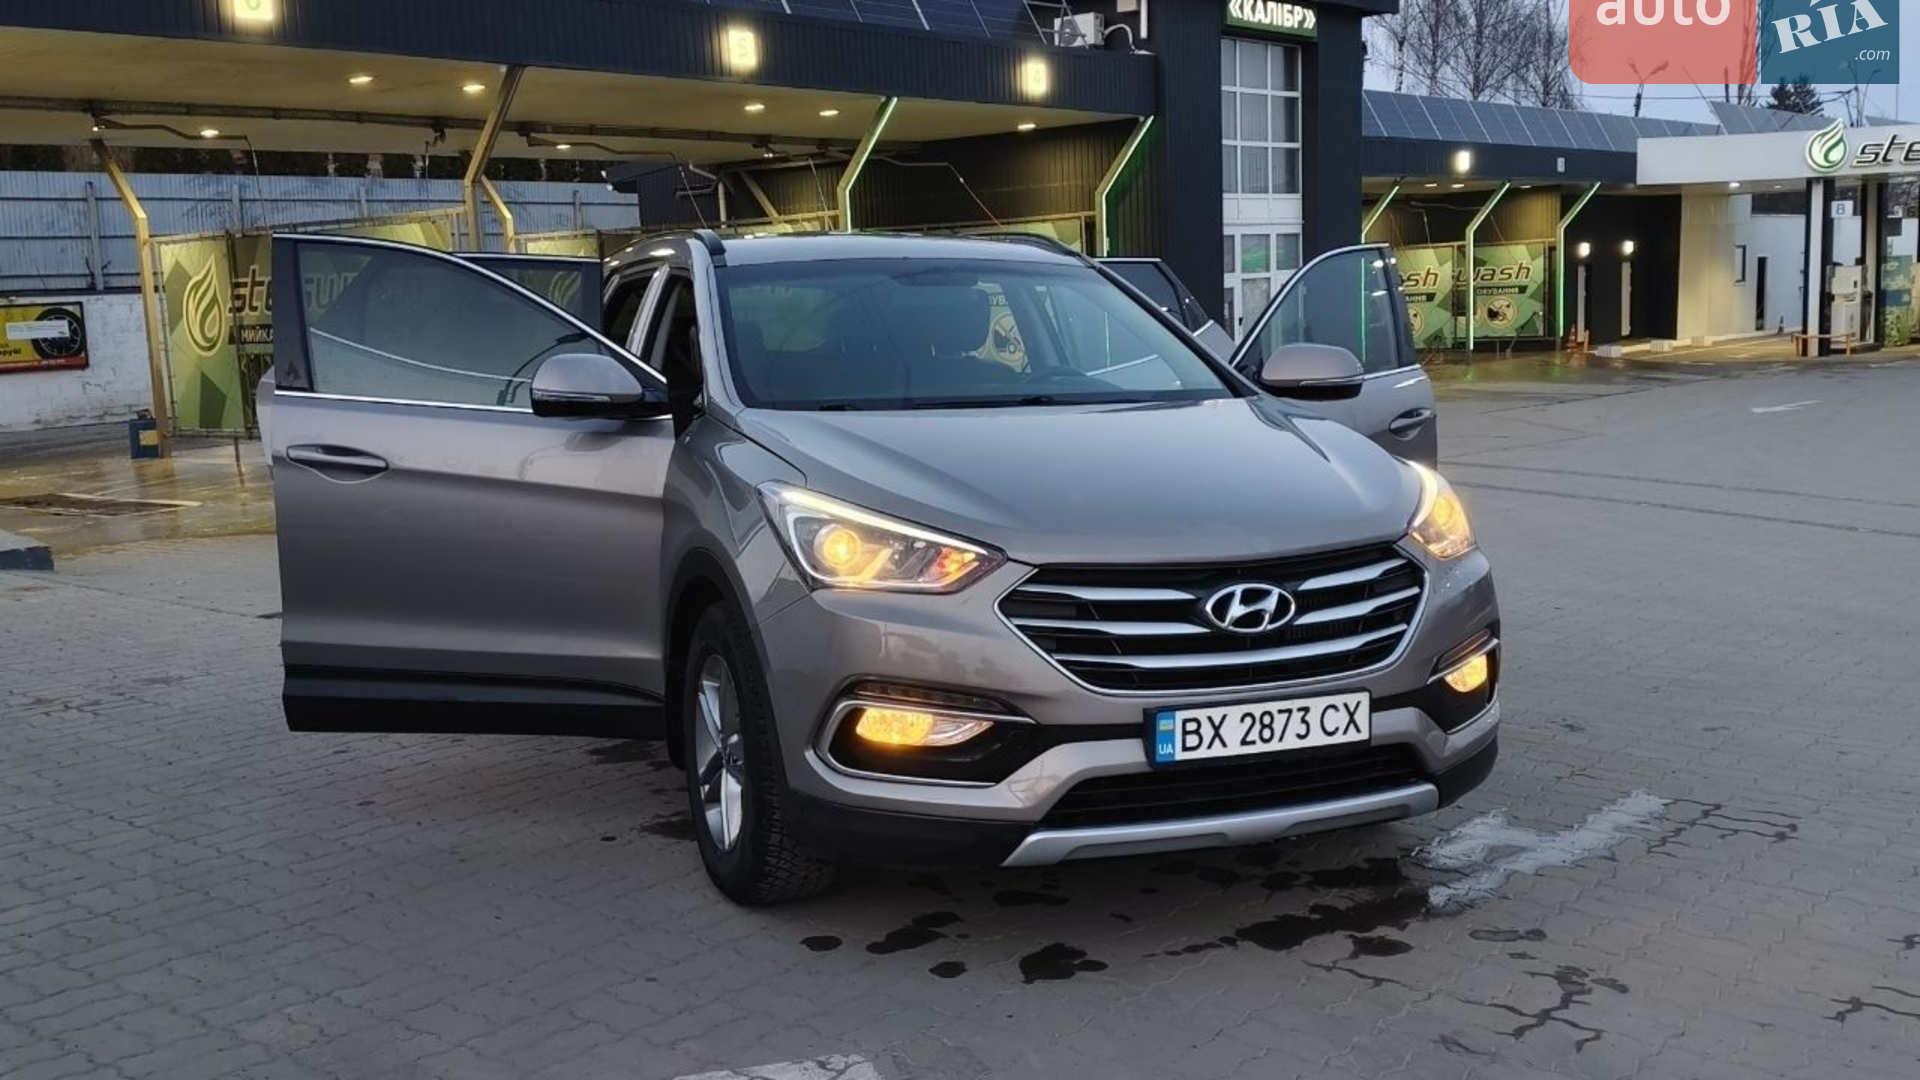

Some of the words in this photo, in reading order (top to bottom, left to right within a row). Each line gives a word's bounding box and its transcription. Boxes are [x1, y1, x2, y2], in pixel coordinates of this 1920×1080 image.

[1228, 0, 1316, 29] «КАЛІБР»
[1836, 203, 1846, 215] 8
[1181, 713, 1228, 752] BX
[1239, 706, 1311, 746] 2873
[1319, 700, 1363, 738] CX
[1158, 744, 1174, 755] UA
